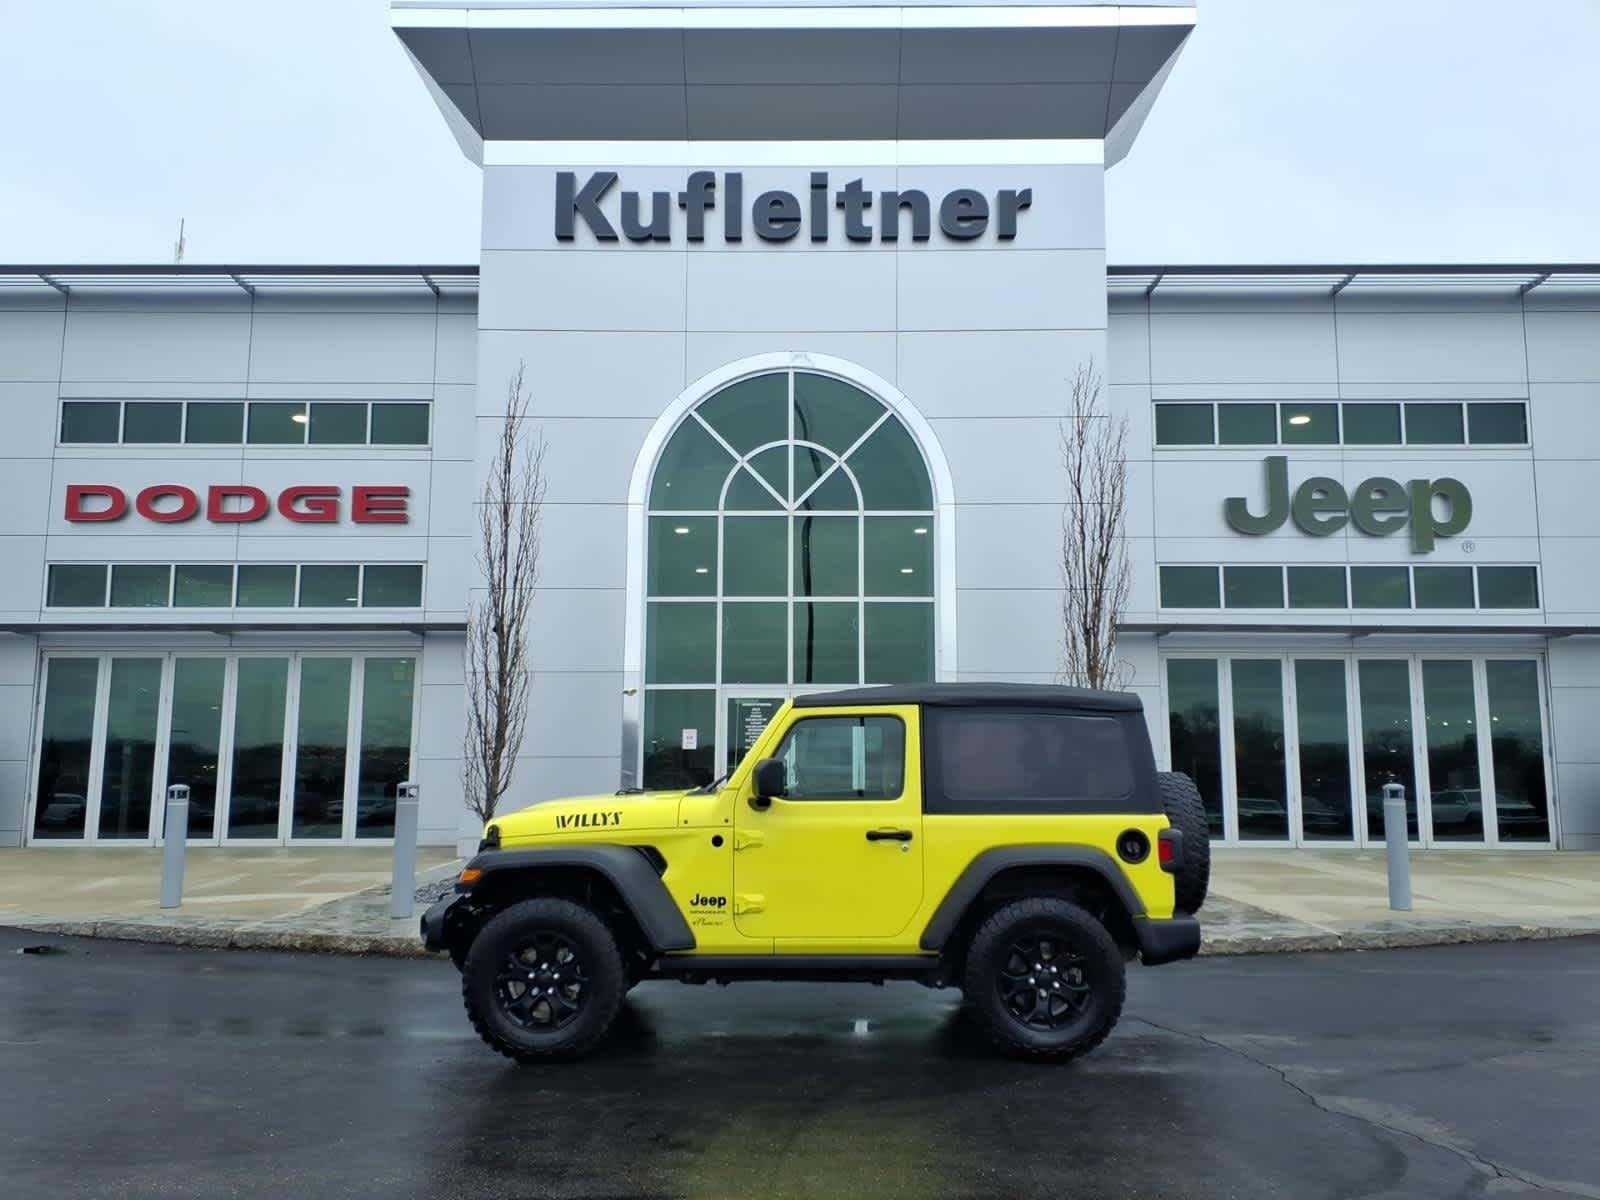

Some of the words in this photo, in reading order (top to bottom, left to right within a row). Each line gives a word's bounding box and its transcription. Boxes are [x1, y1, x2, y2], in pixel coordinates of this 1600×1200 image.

[555, 171, 1032, 243] Kufleitner
[64, 484, 410, 524] DODGE
[1224, 456, 1472, 555] Jeep
[556, 811, 623, 829] WILLYS
[690, 893, 727, 908] Jeep
